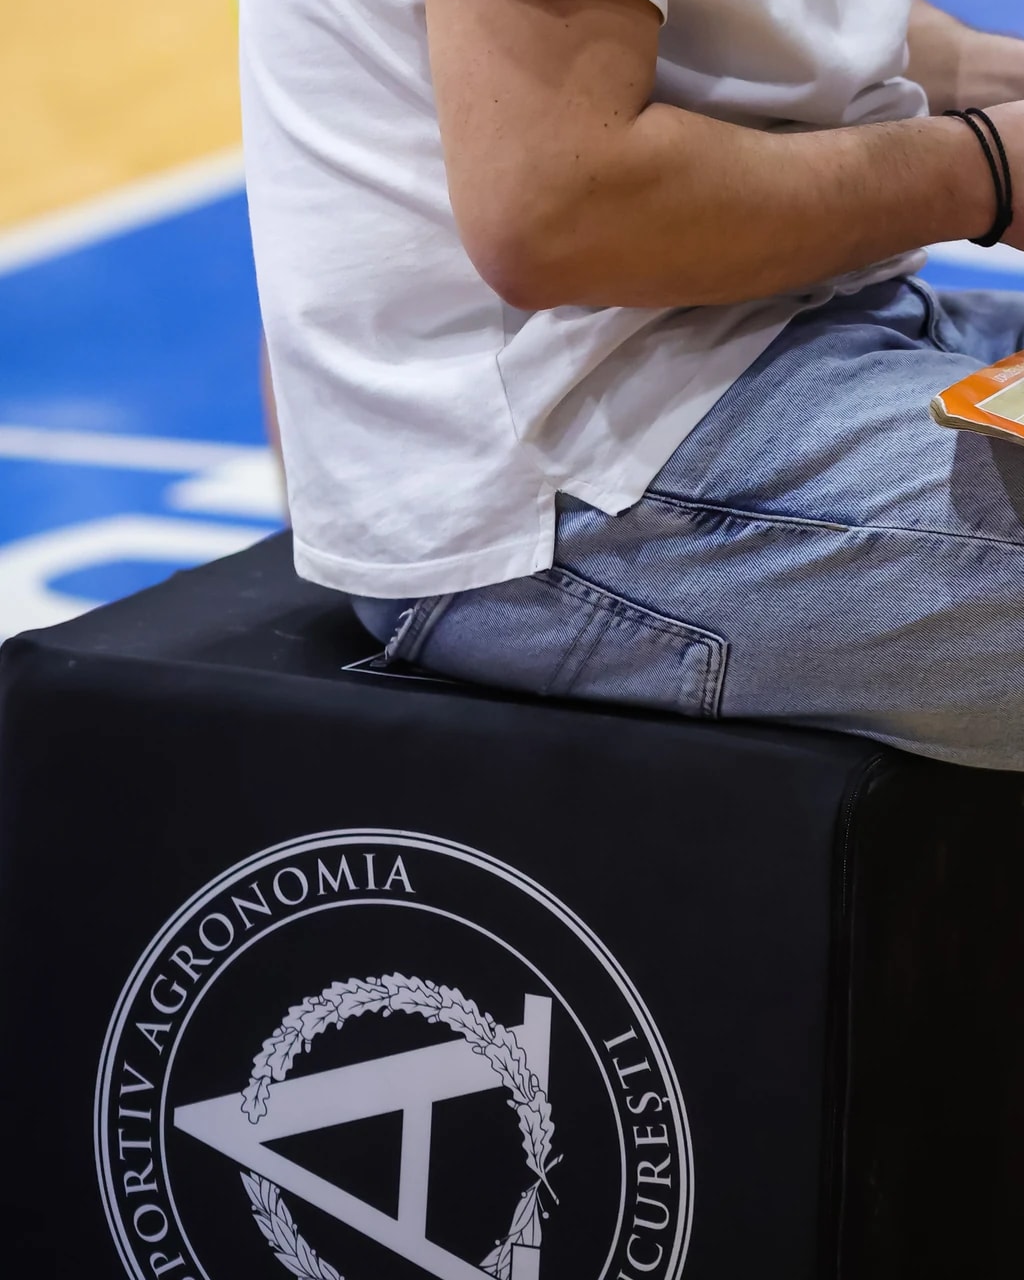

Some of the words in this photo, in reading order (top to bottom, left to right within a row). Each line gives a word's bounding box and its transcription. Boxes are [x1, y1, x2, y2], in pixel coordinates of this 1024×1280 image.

[135, 853, 416, 1055] AGRONOMIA
[118, 1060, 196, 1280] PORTIV
[602, 1025, 676, 1280] CUREȘTI
